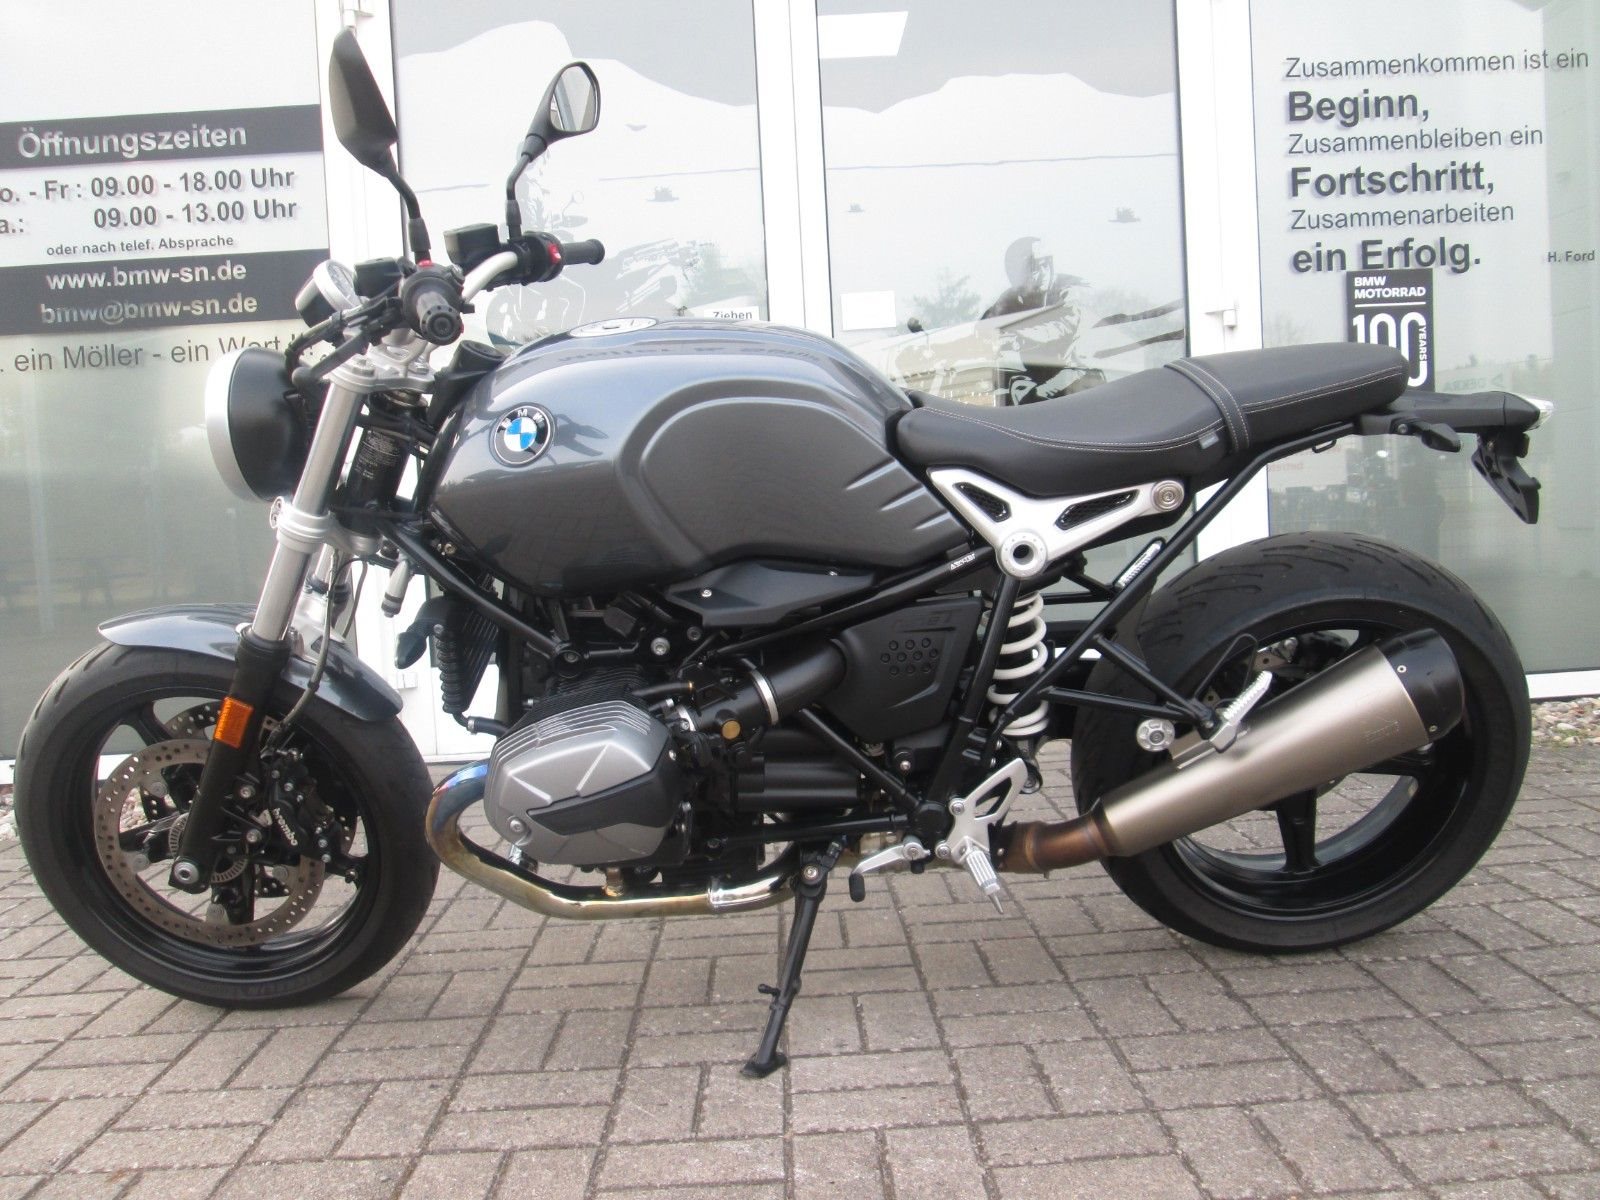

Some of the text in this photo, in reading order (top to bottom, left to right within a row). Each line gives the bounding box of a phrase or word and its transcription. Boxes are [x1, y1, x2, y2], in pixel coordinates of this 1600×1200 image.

[1285, 48, 1590, 79] Zusammenkommen ist ein
[1287, 89, 1430, 128] Beginn,
[17, 124, 248, 159] Öffnungszeiten
[1287, 125, 1544, 155] Zusammenbleiben ein
[90, 174, 155, 198] 09.00
[179, 169, 242, 193] 18.00
[250, 167, 295, 189] Uhr
[1290, 161, 1495, 198] Fortschritt,
[93, 205, 157, 229] 09.00
[181, 200, 245, 223] 13.00
[253, 199, 297, 220] Uhr
[1290, 203, 1515, 231] Zusammenarbeiten
[46, 234, 234, 256] oder nach telef. Absprache
[1291, 237, 1482, 274] ein Erfolg.
[1547, 250, 1595, 263] H. Ford
[45, 260, 248, 290] www.bmw-sn.de
[1354, 276, 1387, 287] BMW
[1354, 287, 1427, 299] MOTORRAD
[40, 292, 259, 329] bmw@bmw-sn.de
[14, 348, 53, 372] ein
[63, 343, 144, 369] Möller
[170, 339, 210, 364] ein
[1418, 326, 1428, 361] YEARS
[501, 408, 545, 428] BMW
